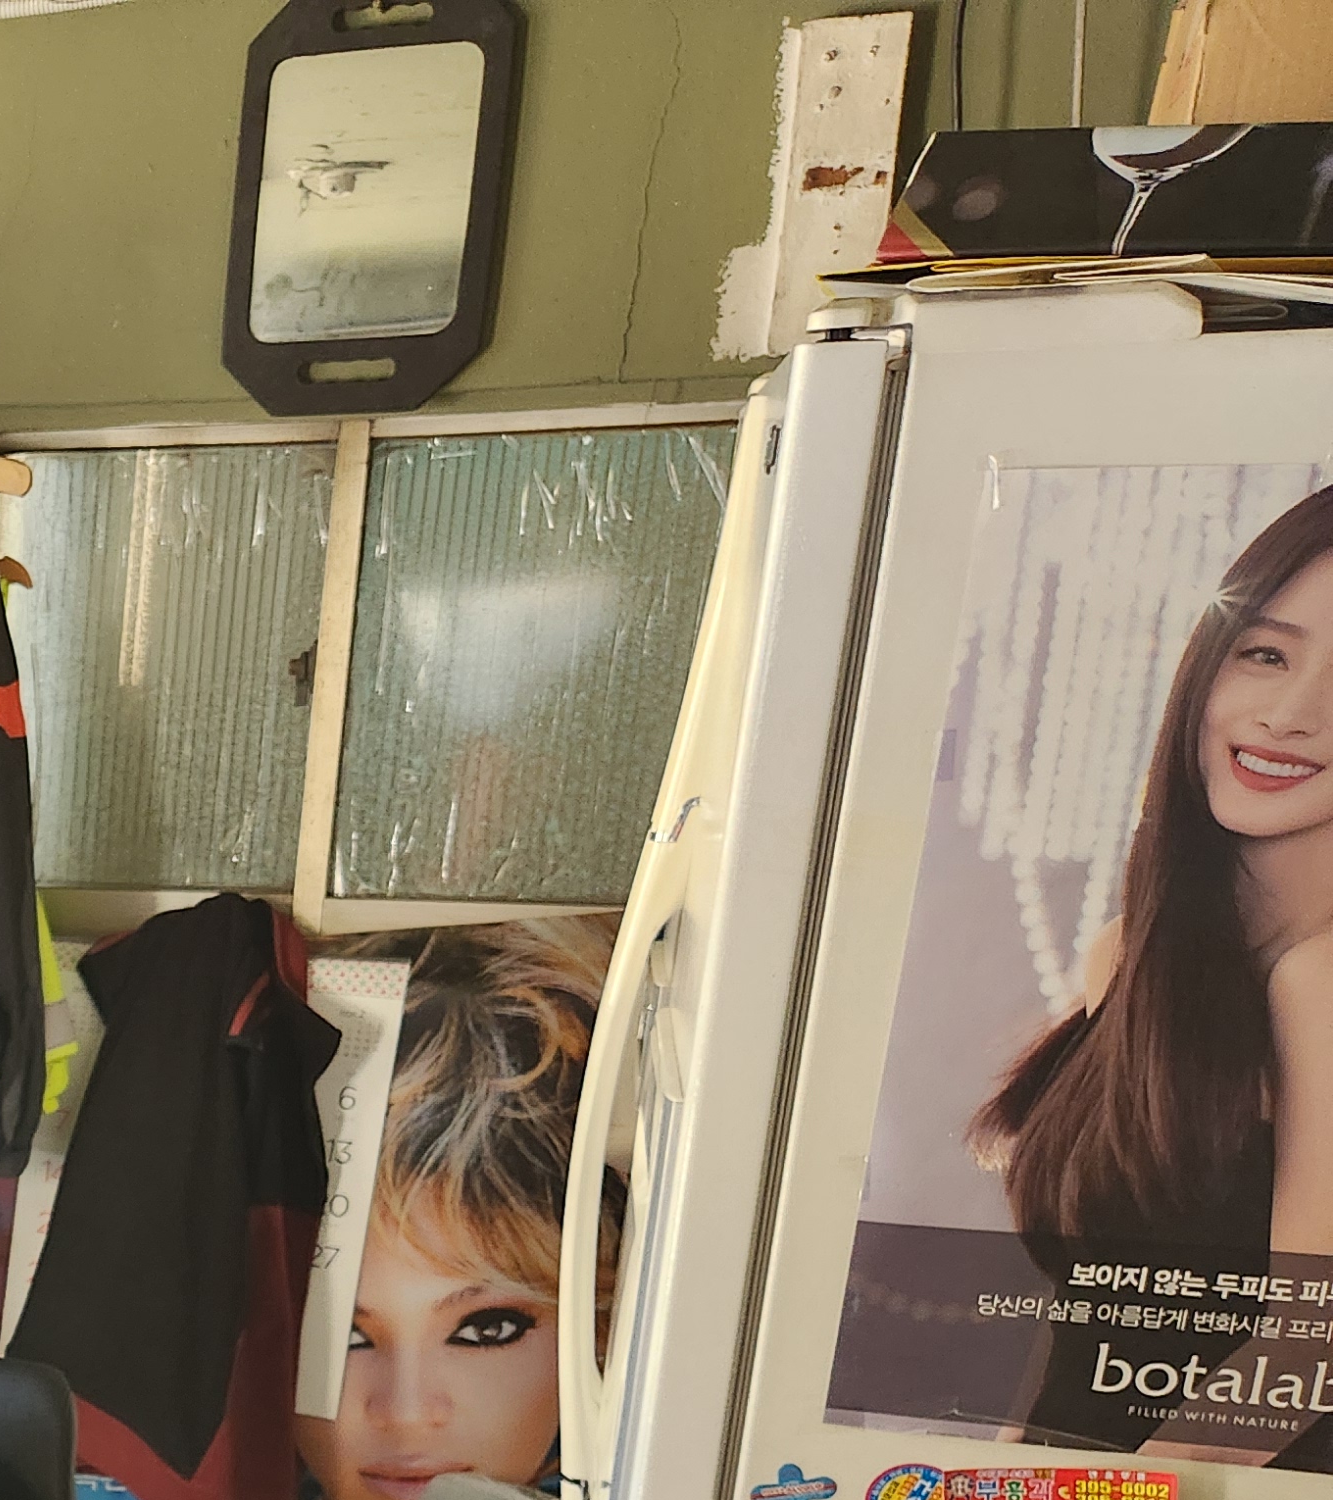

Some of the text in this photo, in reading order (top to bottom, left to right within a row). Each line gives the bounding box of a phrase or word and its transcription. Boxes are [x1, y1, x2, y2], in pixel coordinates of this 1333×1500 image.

[338, 1085, 357, 1110] 6
[326, 1138, 353, 1164] 13
[1068, 1263, 1333, 1308] 보이지 않는 두피도 피
[977, 1294, 1044, 1320] 당신의
[1047, 1300, 1093, 1324] 삶을
[1096, 1303, 1190, 1332] 아름답게
[1192, 1311, 1282, 1340] 변화시킬
[1128, 1405, 1300, 1433] FILLED WITH NATURE
